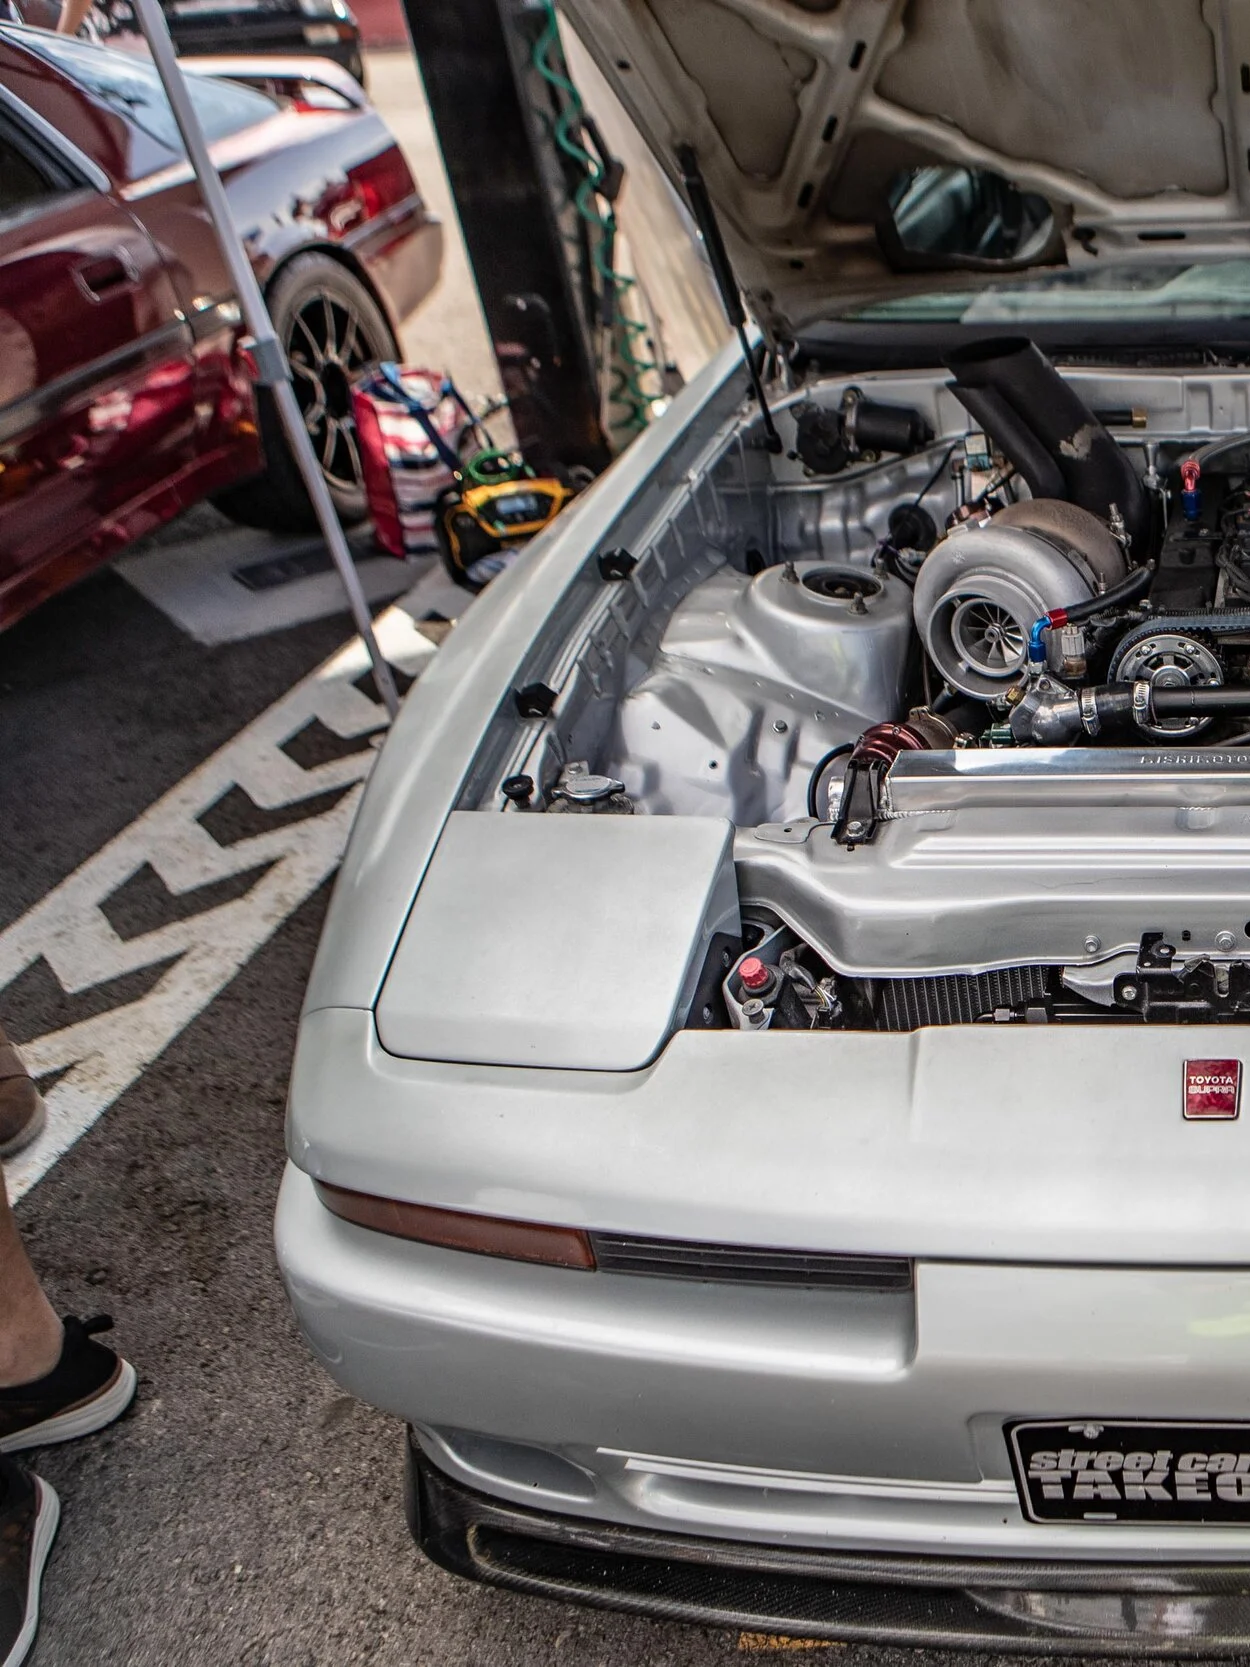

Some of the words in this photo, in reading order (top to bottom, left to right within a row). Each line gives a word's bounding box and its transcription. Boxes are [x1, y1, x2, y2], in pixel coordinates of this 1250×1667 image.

[1189, 1075, 1234, 1085] TOYOTA
[1188, 1085, 1236, 1095] SUPRA
[1029, 1449, 1173, 1473] street
